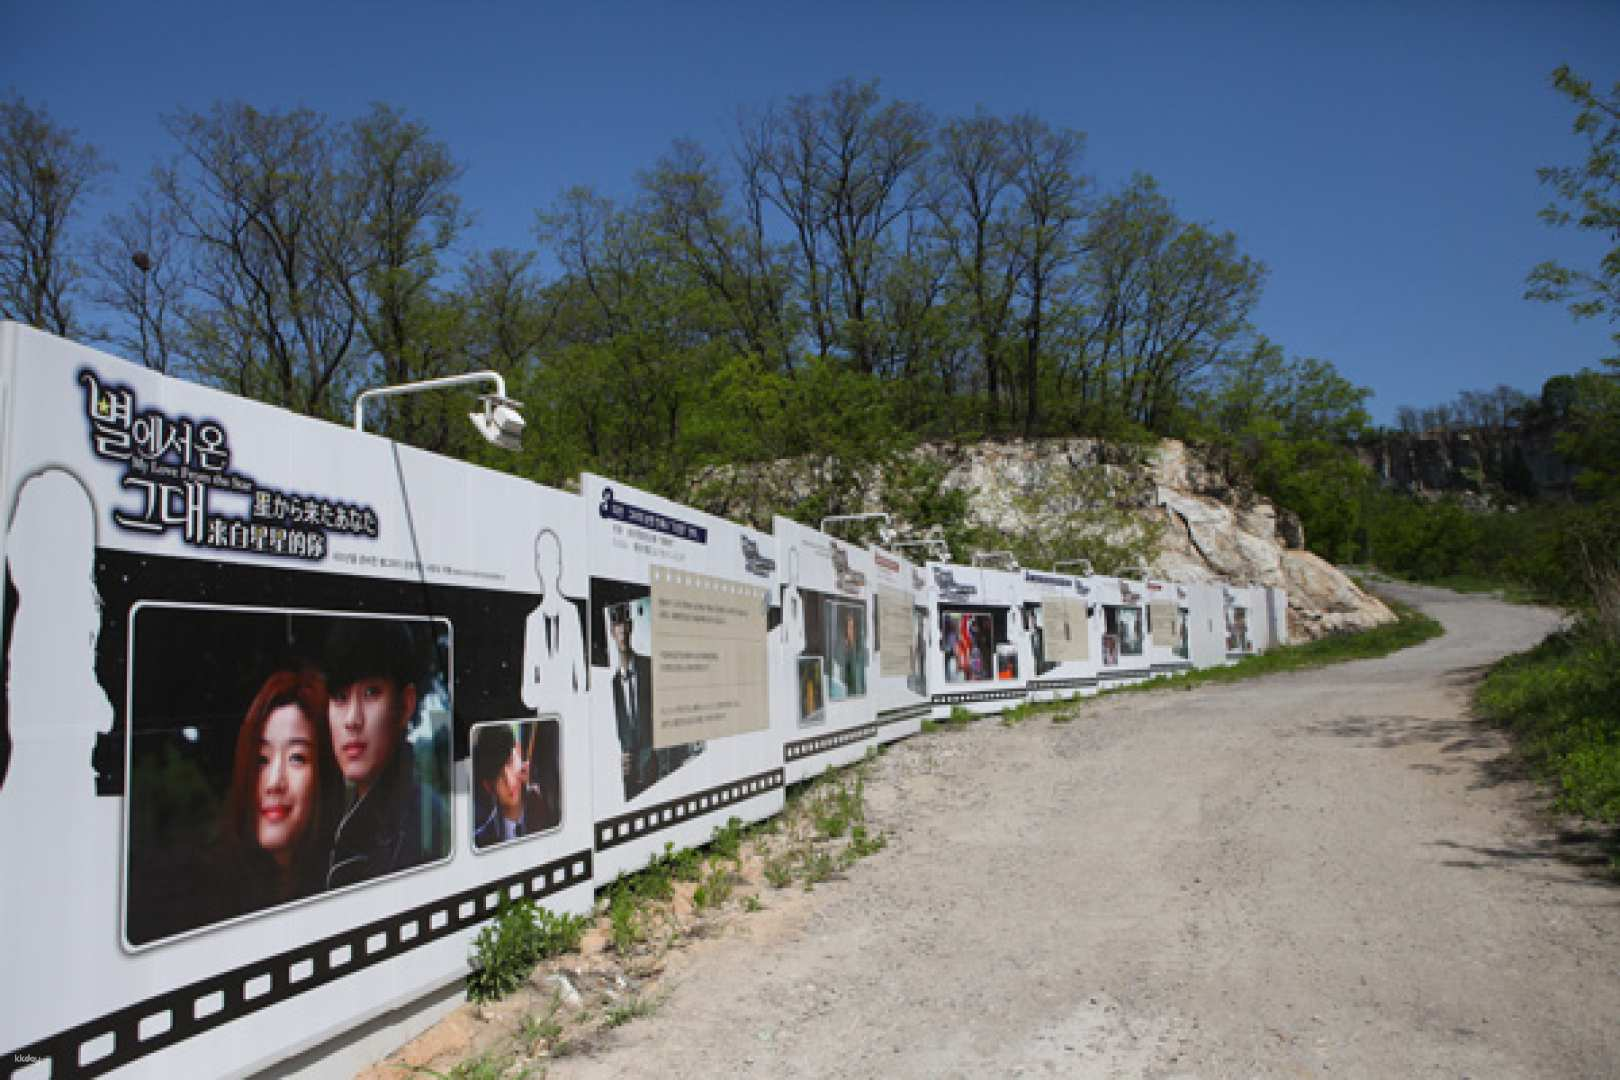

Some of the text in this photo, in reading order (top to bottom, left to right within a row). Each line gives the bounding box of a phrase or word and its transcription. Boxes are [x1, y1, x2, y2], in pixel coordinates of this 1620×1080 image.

[80, 371, 228, 470] 별에서 온
[115, 476, 207, 544] 그대
